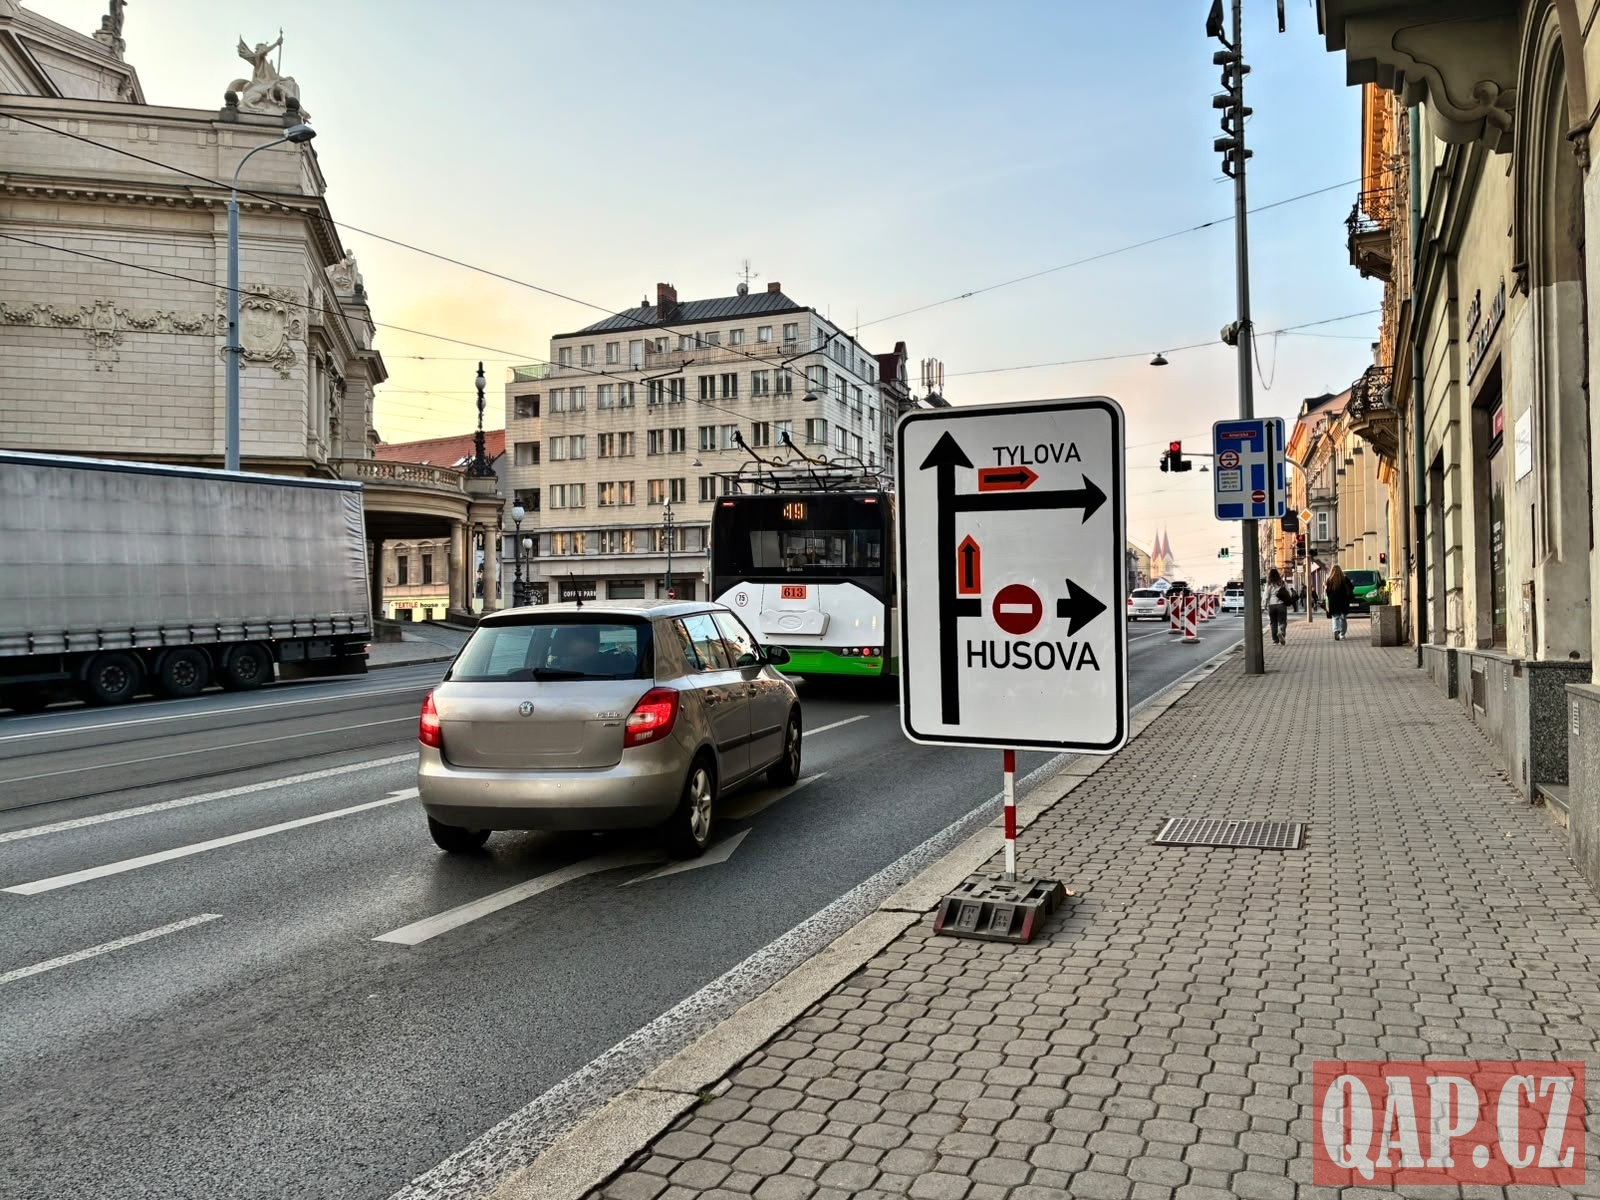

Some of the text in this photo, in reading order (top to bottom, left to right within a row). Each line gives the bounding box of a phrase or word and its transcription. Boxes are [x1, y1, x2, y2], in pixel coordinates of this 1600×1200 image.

[992, 442, 1081, 466] TYLOVA
[738, 594, 746, 602] 75
[784, 587, 803, 597] 613
[967, 640, 1100, 671] HUSOVA
